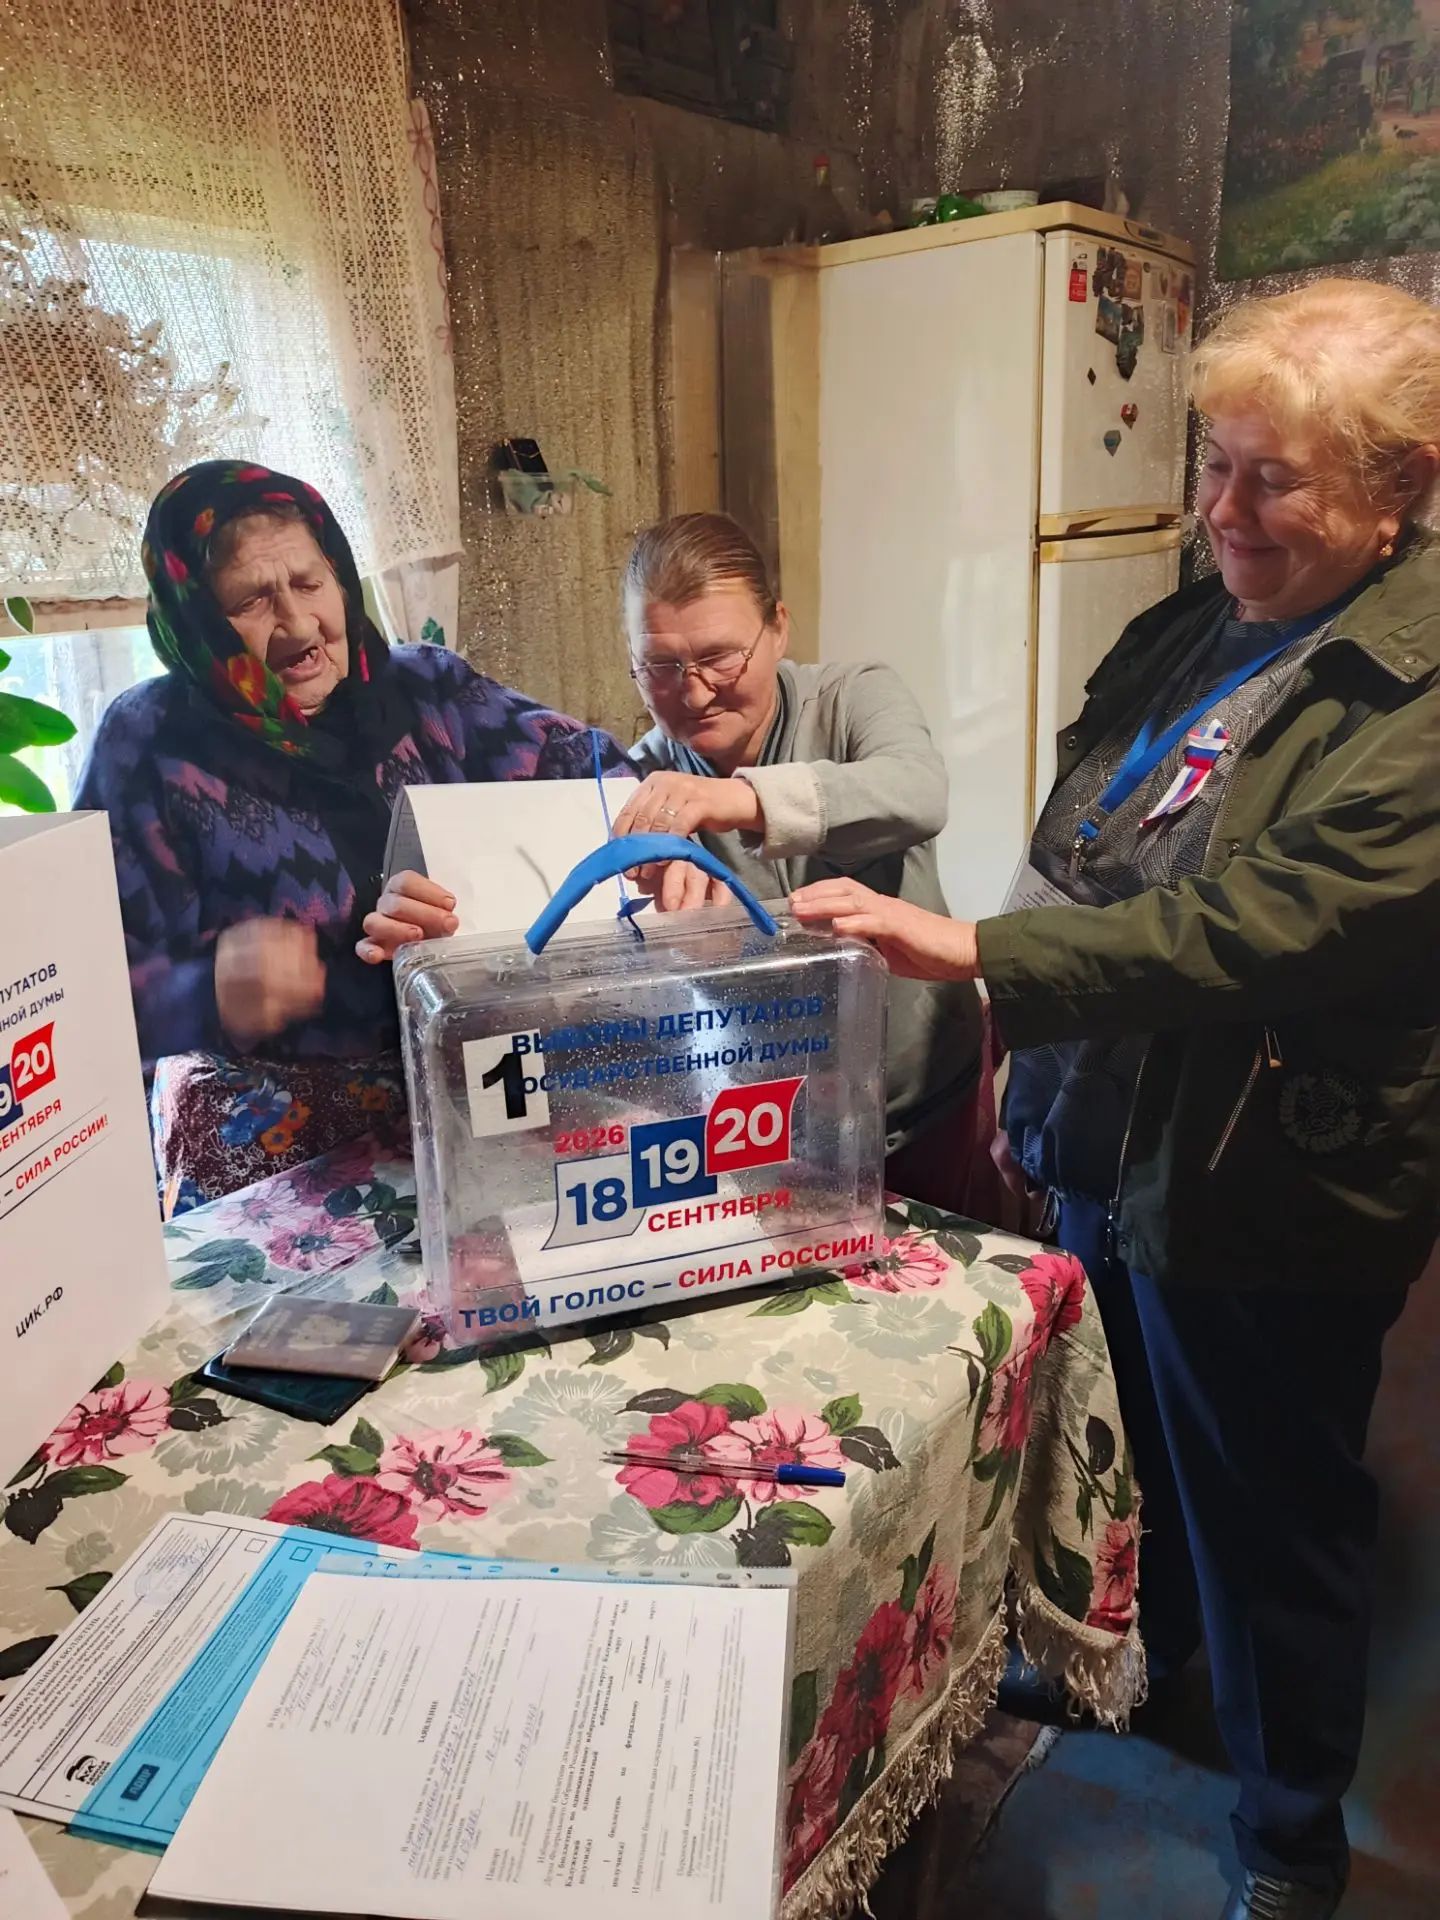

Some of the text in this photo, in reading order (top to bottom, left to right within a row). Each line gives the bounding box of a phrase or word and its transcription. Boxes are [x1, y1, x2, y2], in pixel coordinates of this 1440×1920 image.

[30, 988, 64, 1017] ДУМЫ
[511, 996, 824, 1056] ВЫБОРЫ ДЕПУТАТОВ
[14, 1041, 50, 1089] 20
[482, 1050, 527, 1121] 1
[514, 1034, 830, 1095] ОСУДАРСТВЕННОЙ ДУМЫ
[16, 1156, 52, 1190] СИЛА
[54, 1114, 109, 1161] РОССИИ!
[553, 1124, 625, 1154] 2026
[566, 1102, 784, 1226] 18 19 20
[647, 1189, 792, 1234] СЕНТЯБРЯ
[15, 1286, 64, 1338] ЦИК.РФ
[460, 1290, 541, 1330] ТВОЙ
[550, 1278, 646, 1315] ГОЛОС
[677, 1256, 753, 1290] СИЛА
[760, 1234, 875, 1274] РОССИИ!
